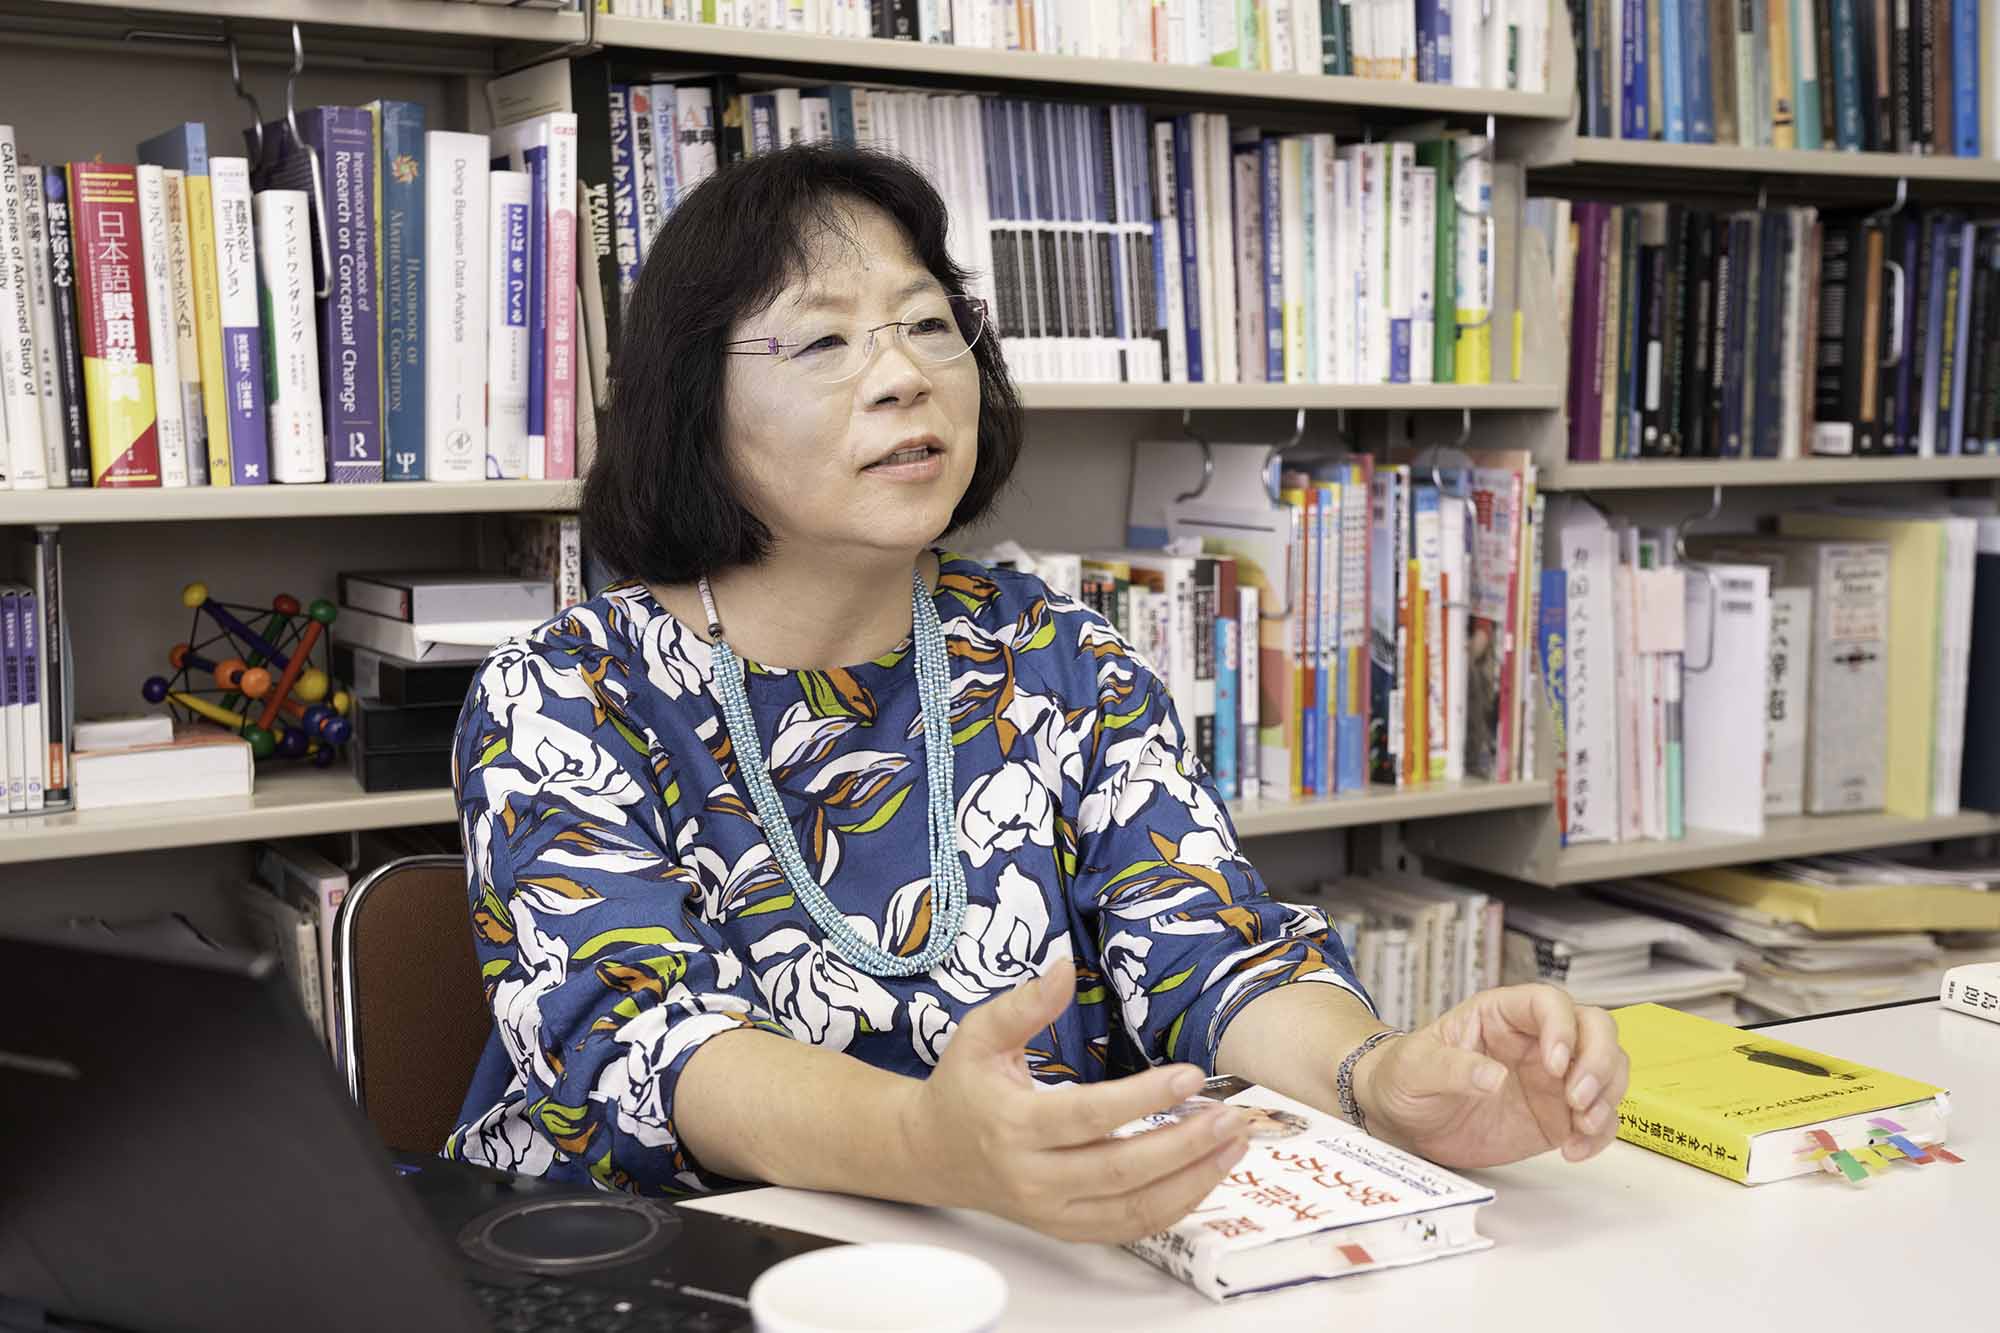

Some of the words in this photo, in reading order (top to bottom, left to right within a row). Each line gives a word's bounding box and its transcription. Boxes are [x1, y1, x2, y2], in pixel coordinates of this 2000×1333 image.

[1, 143, 16, 193] CARLS
[335, 151, 351, 227] Research
[352, 151, 367, 228] International
[453, 159, 467, 195] Doing
[7, 198, 18, 241] Series
[338, 230, 350, 248] on
[453, 200, 467, 256] Bayesian
[11, 246, 24, 259] of
[283, 205, 303, 343] マインドワンダリング
[355, 231, 370, 295] Handbook
[389, 209, 404, 322] MATHEMATICAL
[456, 260, 467, 289] Data
[14, 264, 30, 334] Advanced
[336, 253, 354, 345] Conceptual
[359, 298, 370, 311] of
[406, 258, 421, 342] HANDBOOK
[453, 294, 467, 343] Analysis
[20, 339, 33, 378] Study
[340, 351, 357, 413] Change
[389, 328, 404, 411] COGNITION
[407, 346, 419, 365] OF
[25, 381, 36, 396] of
